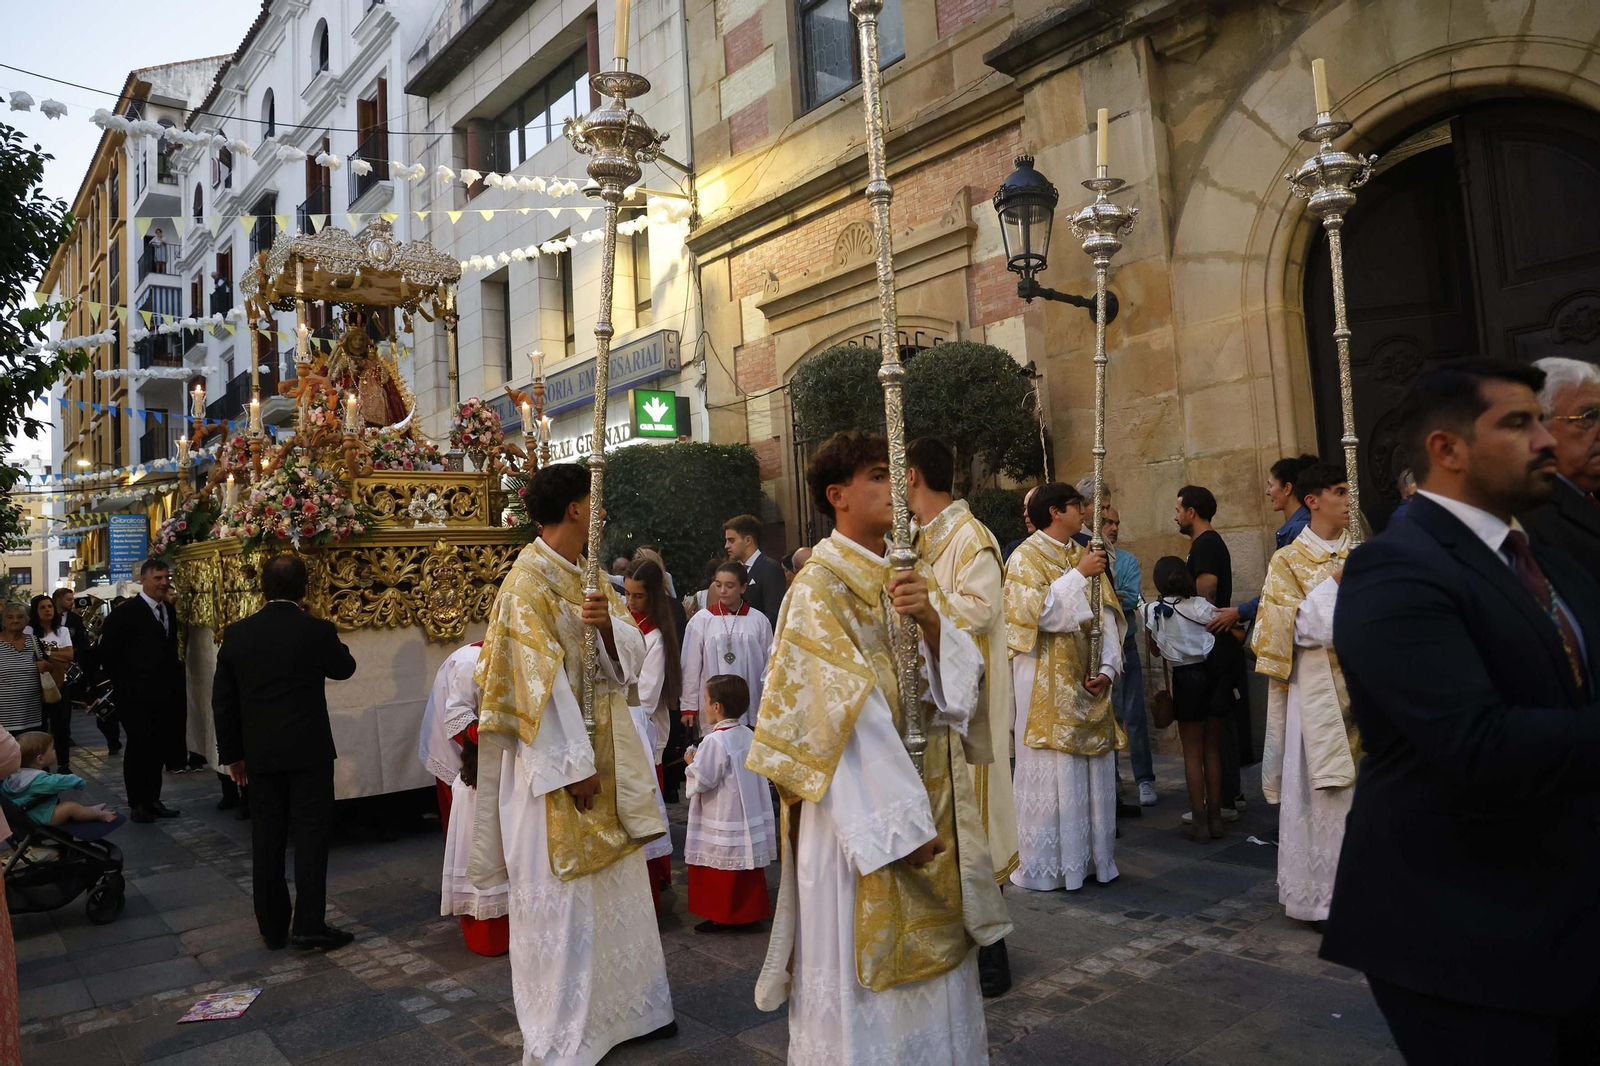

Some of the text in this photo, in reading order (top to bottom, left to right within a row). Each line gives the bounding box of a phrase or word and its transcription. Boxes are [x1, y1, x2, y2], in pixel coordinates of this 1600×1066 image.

[667, 333, 675, 343] C
[578, 342, 662, 391] EMESARIAL
[668, 358, 676, 369] G
[576, 422, 631, 454] GRNAD
